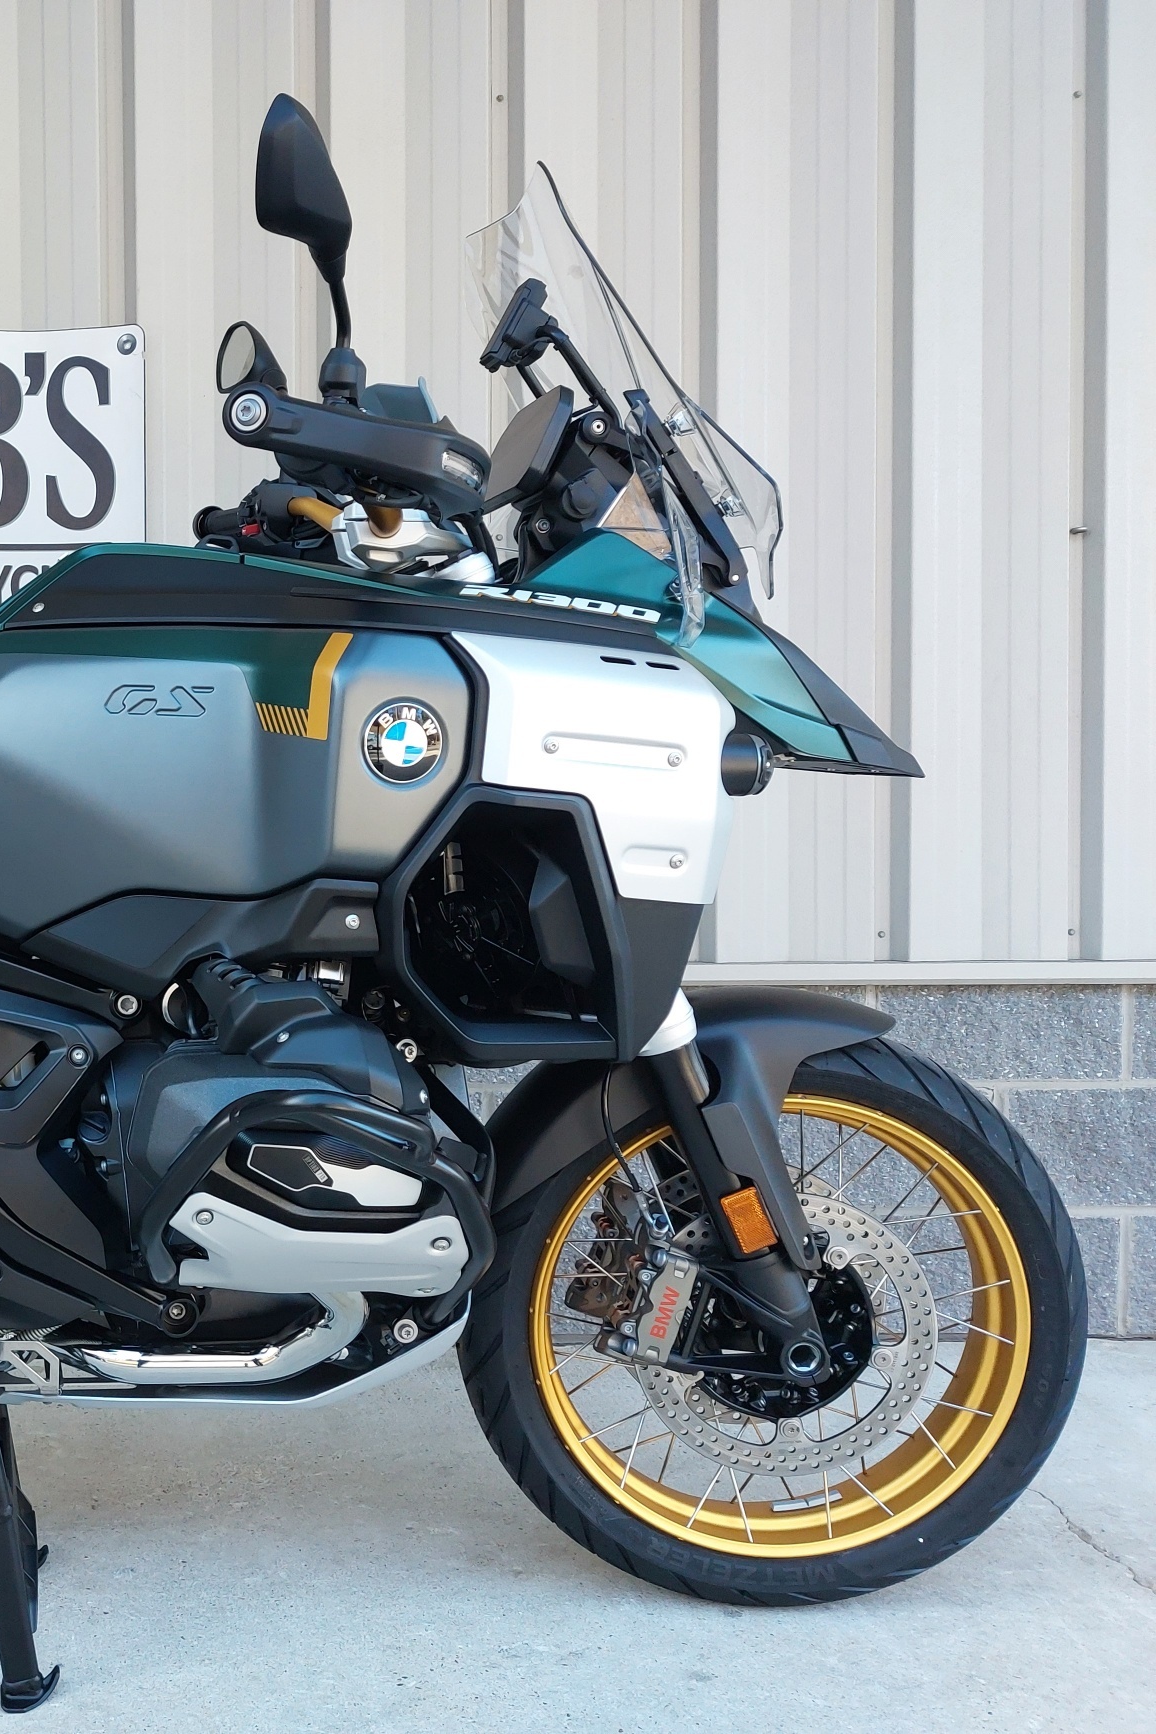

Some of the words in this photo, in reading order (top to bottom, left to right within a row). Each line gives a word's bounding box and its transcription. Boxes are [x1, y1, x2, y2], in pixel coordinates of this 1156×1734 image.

[459, 584, 662, 625] R1300
[104, 684, 215, 717] GS
[378, 706, 438, 736] BMW
[650, 1285, 680, 1339] BMW
[647, 1535, 836, 1586] METZELER
